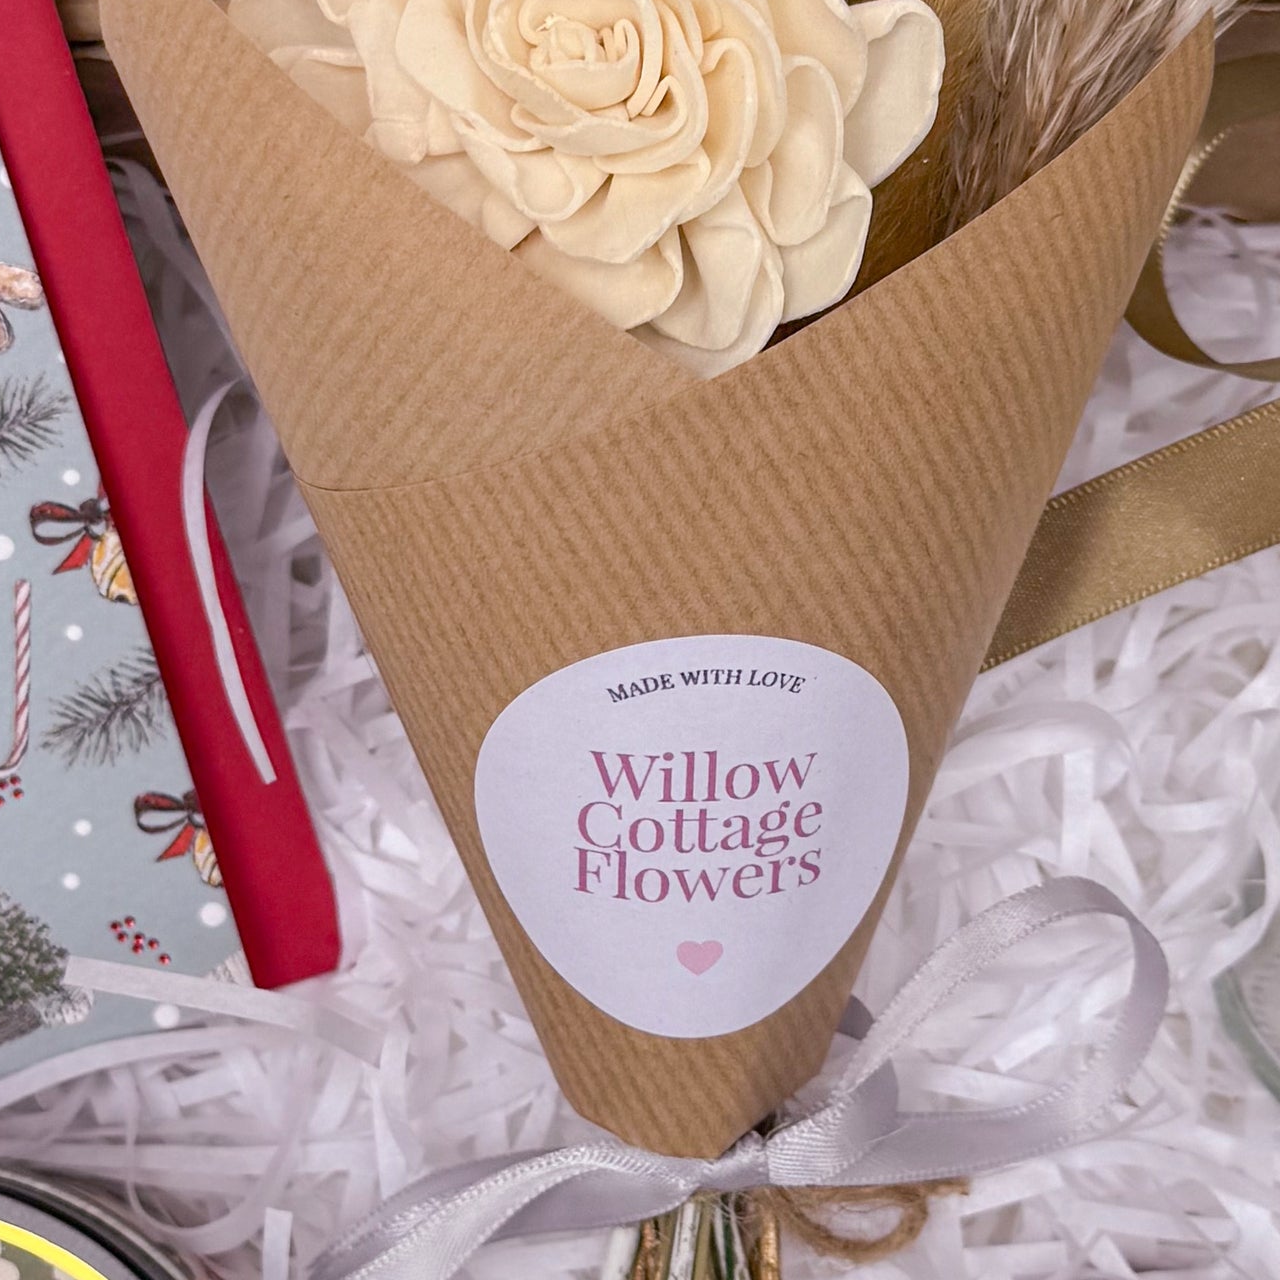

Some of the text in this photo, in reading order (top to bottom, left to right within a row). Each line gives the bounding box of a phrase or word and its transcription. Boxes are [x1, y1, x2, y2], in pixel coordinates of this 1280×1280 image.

[606, 669, 806, 703] MADE WITH LOVE
[589, 750, 818, 803] Willow
[577, 800, 823, 857] Cottage
[573, 846, 822, 904] Flowers
